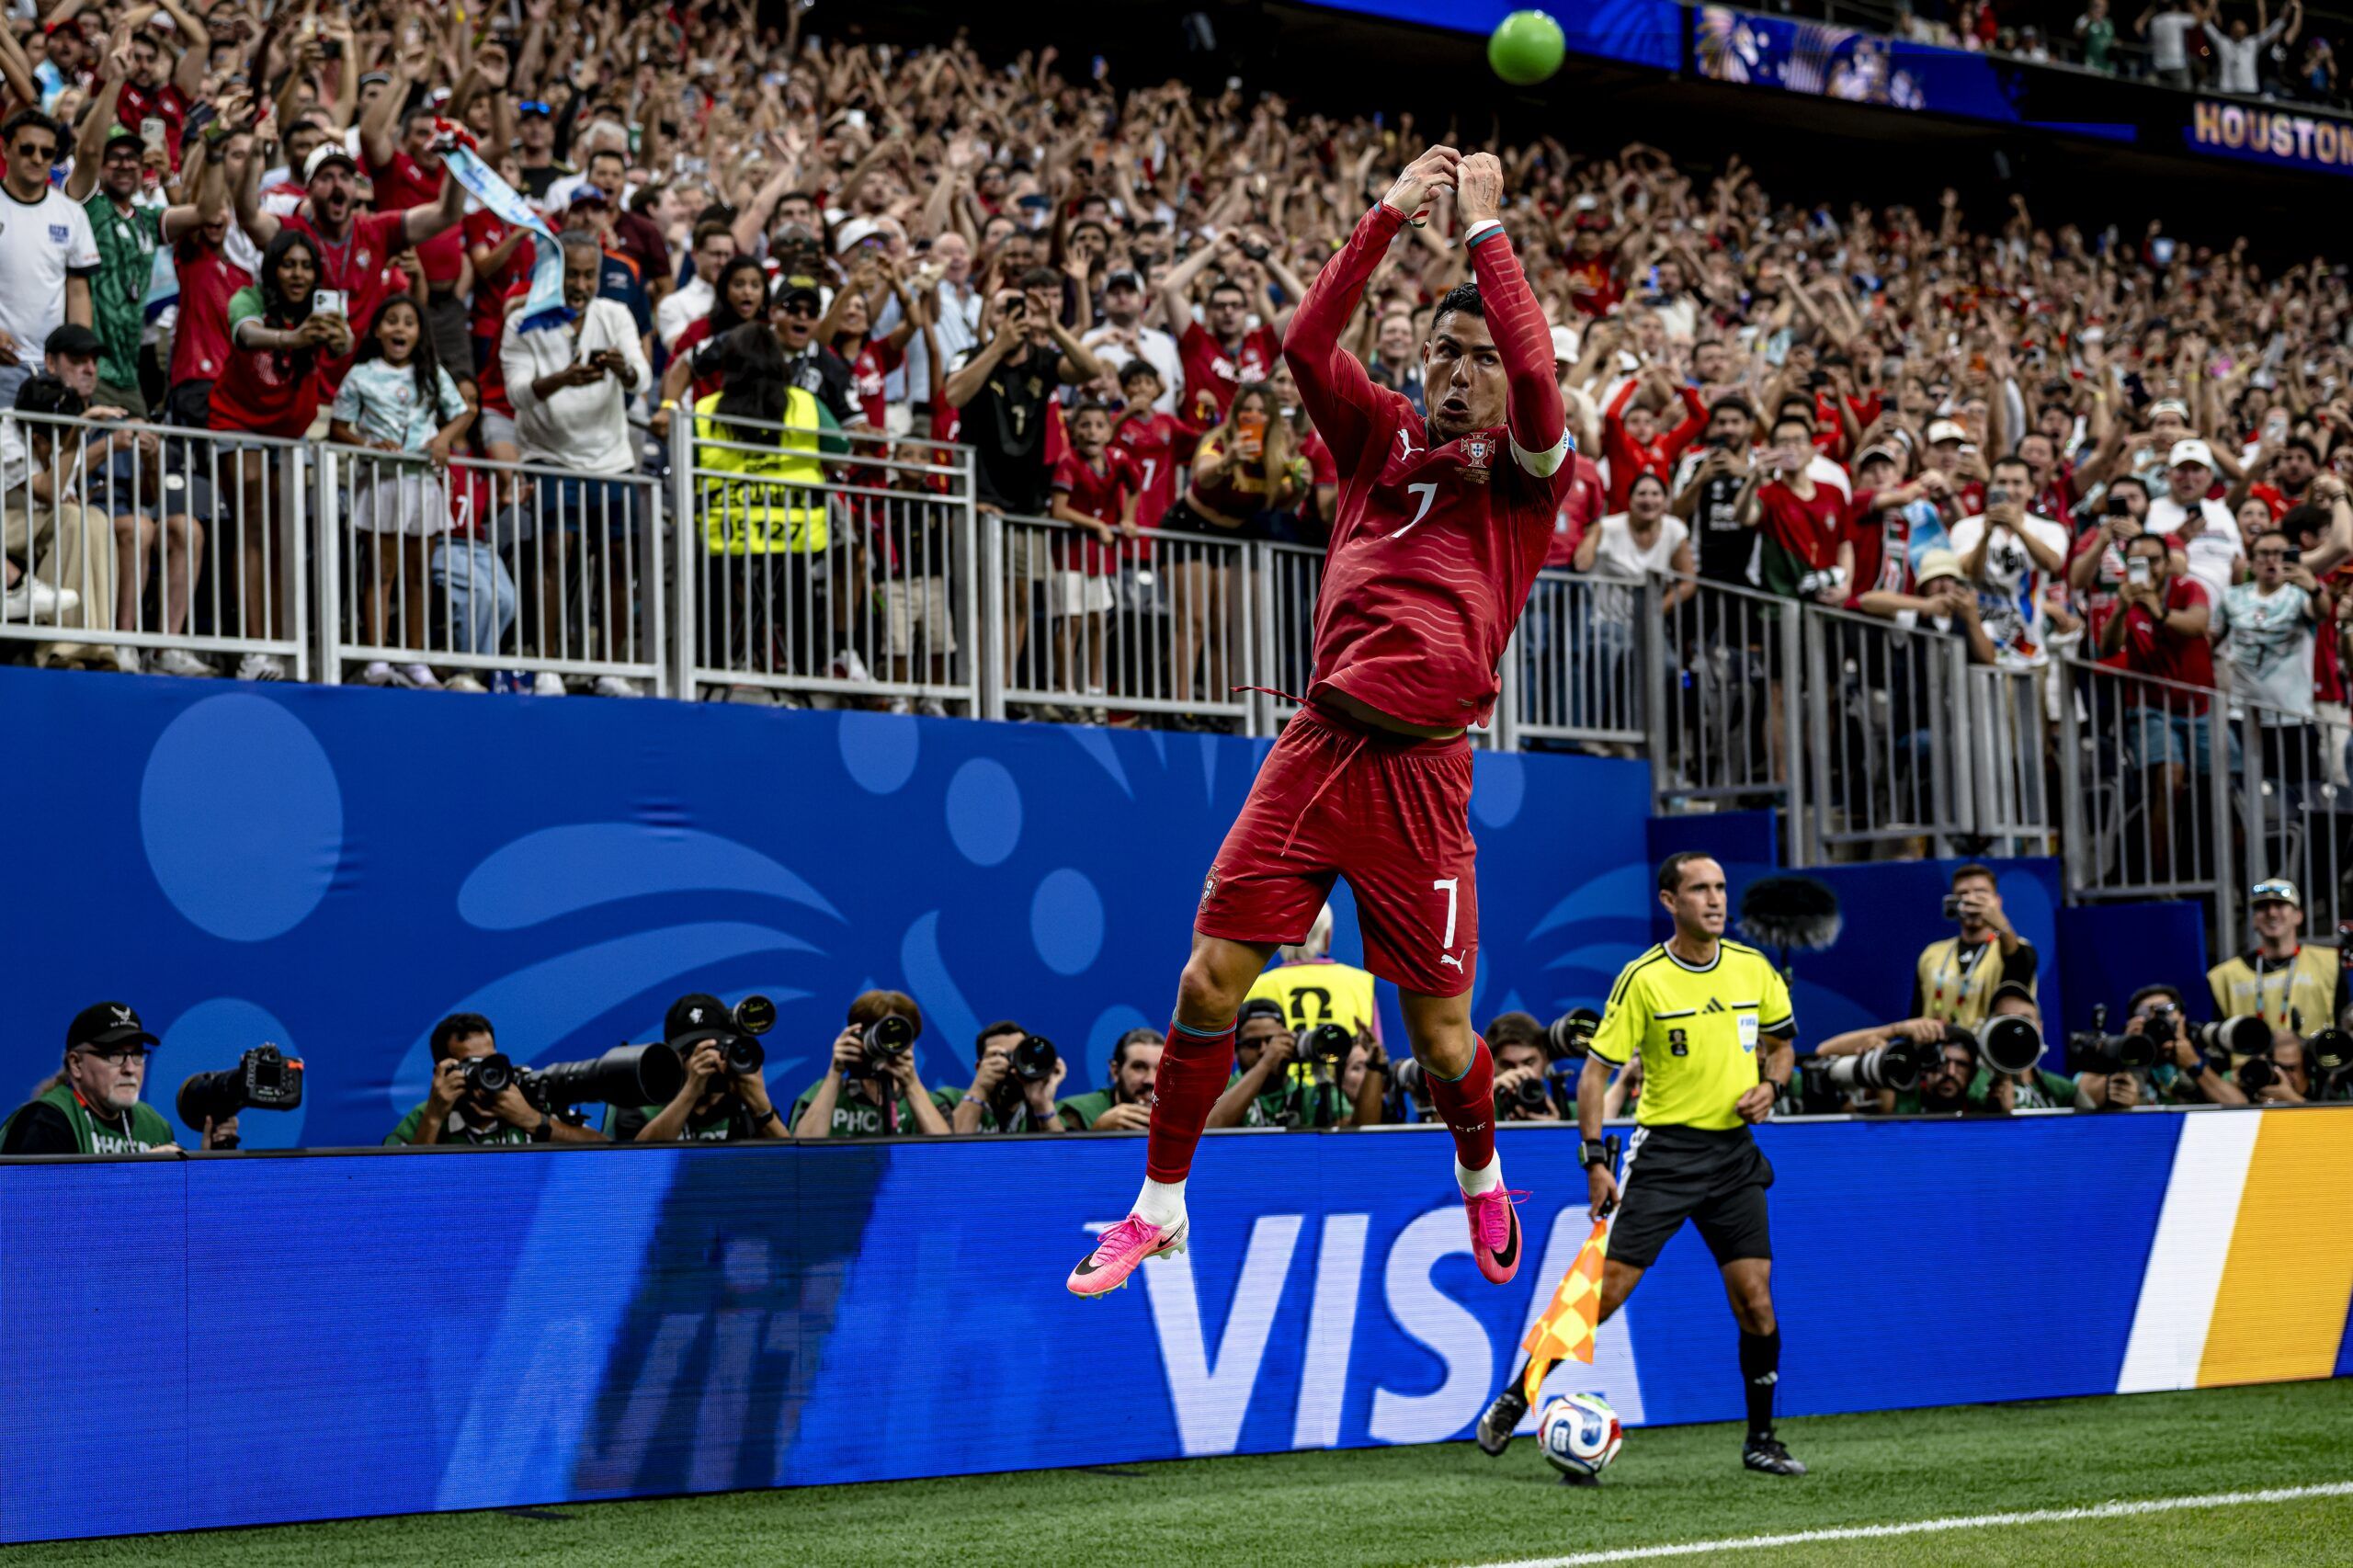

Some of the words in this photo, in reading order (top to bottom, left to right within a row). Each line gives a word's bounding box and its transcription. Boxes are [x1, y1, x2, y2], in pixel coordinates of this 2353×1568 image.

[1142, 459, 1157, 492] 7
[456, 494, 469, 528] 7
[1391, 483, 1438, 539] 7
[1434, 876, 1458, 949] 7
[1084, 1205, 1645, 1457] VISA
